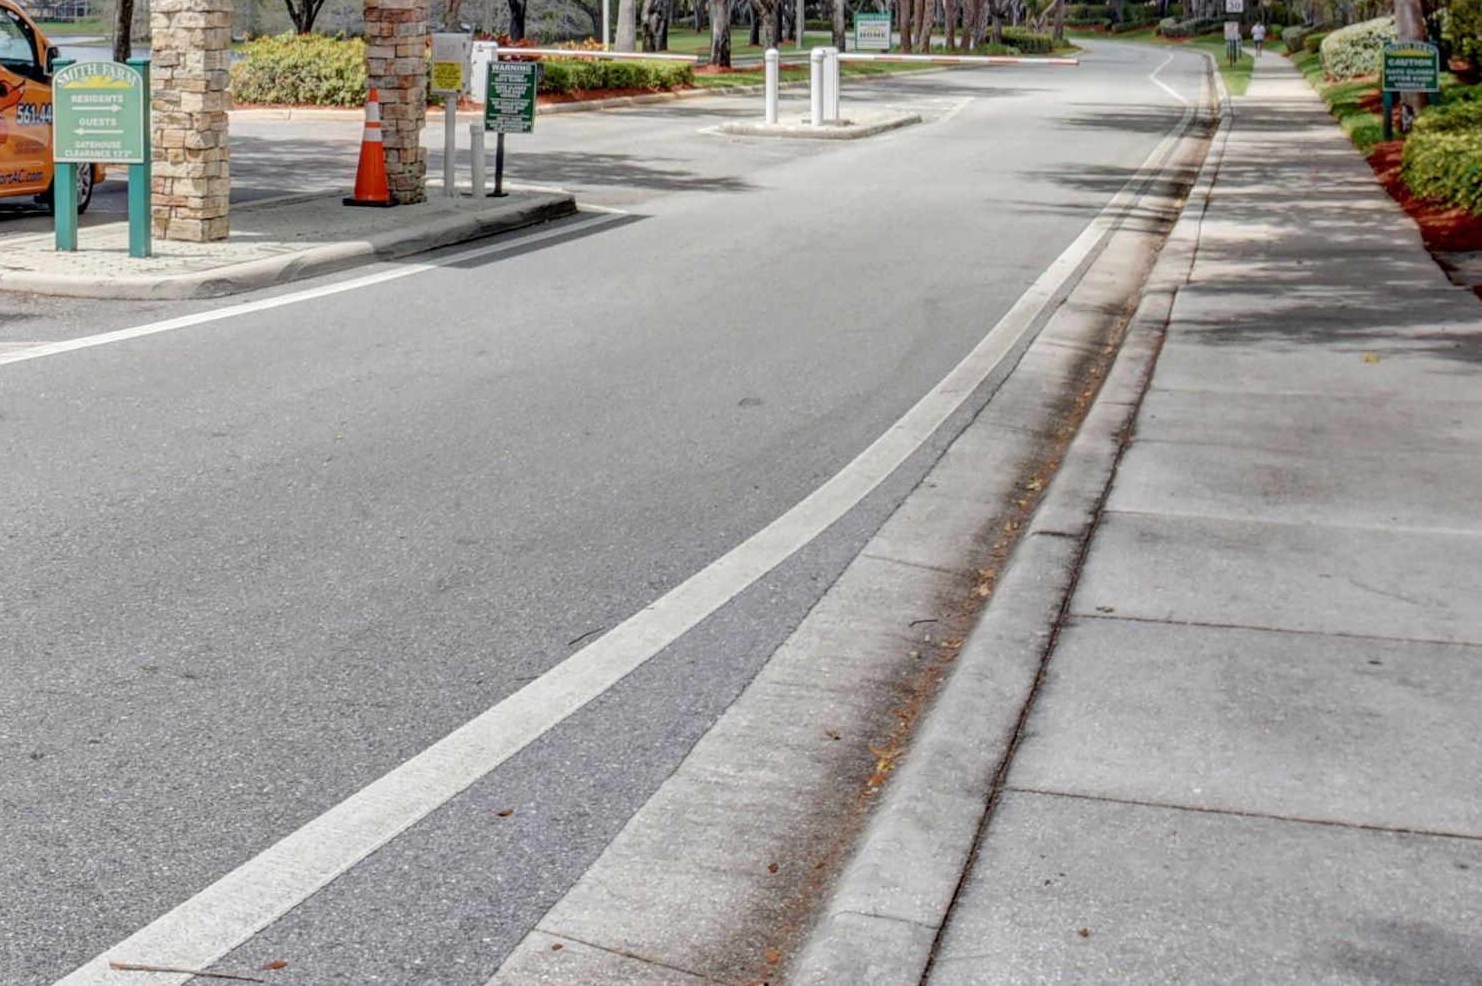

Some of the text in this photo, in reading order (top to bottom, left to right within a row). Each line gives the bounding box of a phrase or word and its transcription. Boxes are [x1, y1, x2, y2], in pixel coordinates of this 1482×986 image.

[1387, 58, 1433, 67] CAUTION
[492, 64, 532, 72] WARNING
[56, 63, 137, 88] SMITH FARM
[71, 94, 124, 104] RESIDENTS
[79, 118, 117, 127] GUESTS
[74, 141, 122, 149] GATEHOUSE
[64, 150, 111, 159] CLEARANCE
